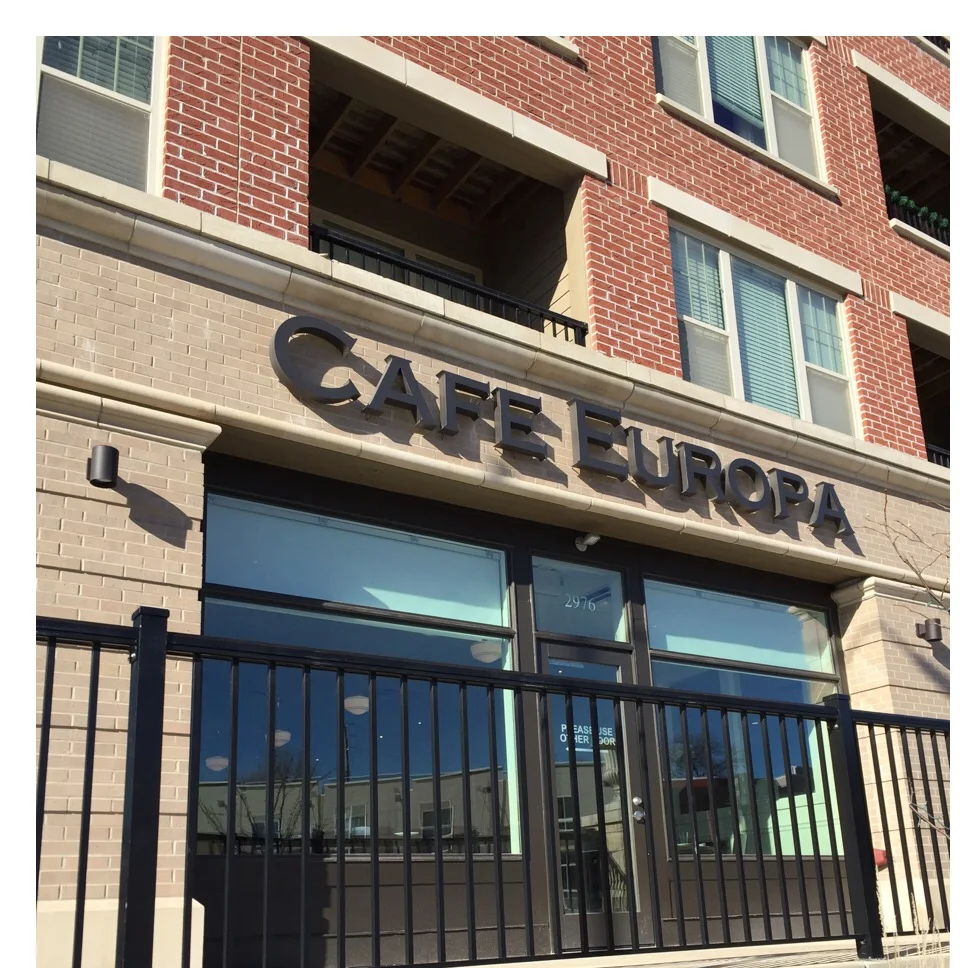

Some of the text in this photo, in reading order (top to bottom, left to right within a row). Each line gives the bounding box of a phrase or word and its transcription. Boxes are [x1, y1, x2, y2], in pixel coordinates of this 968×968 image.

[271, 315, 854, 538] CAFE EUROPA
[565, 593, 597, 612] 2976
[561, 724, 593, 735] PEASE
[560, 734, 590, 745] OHER
